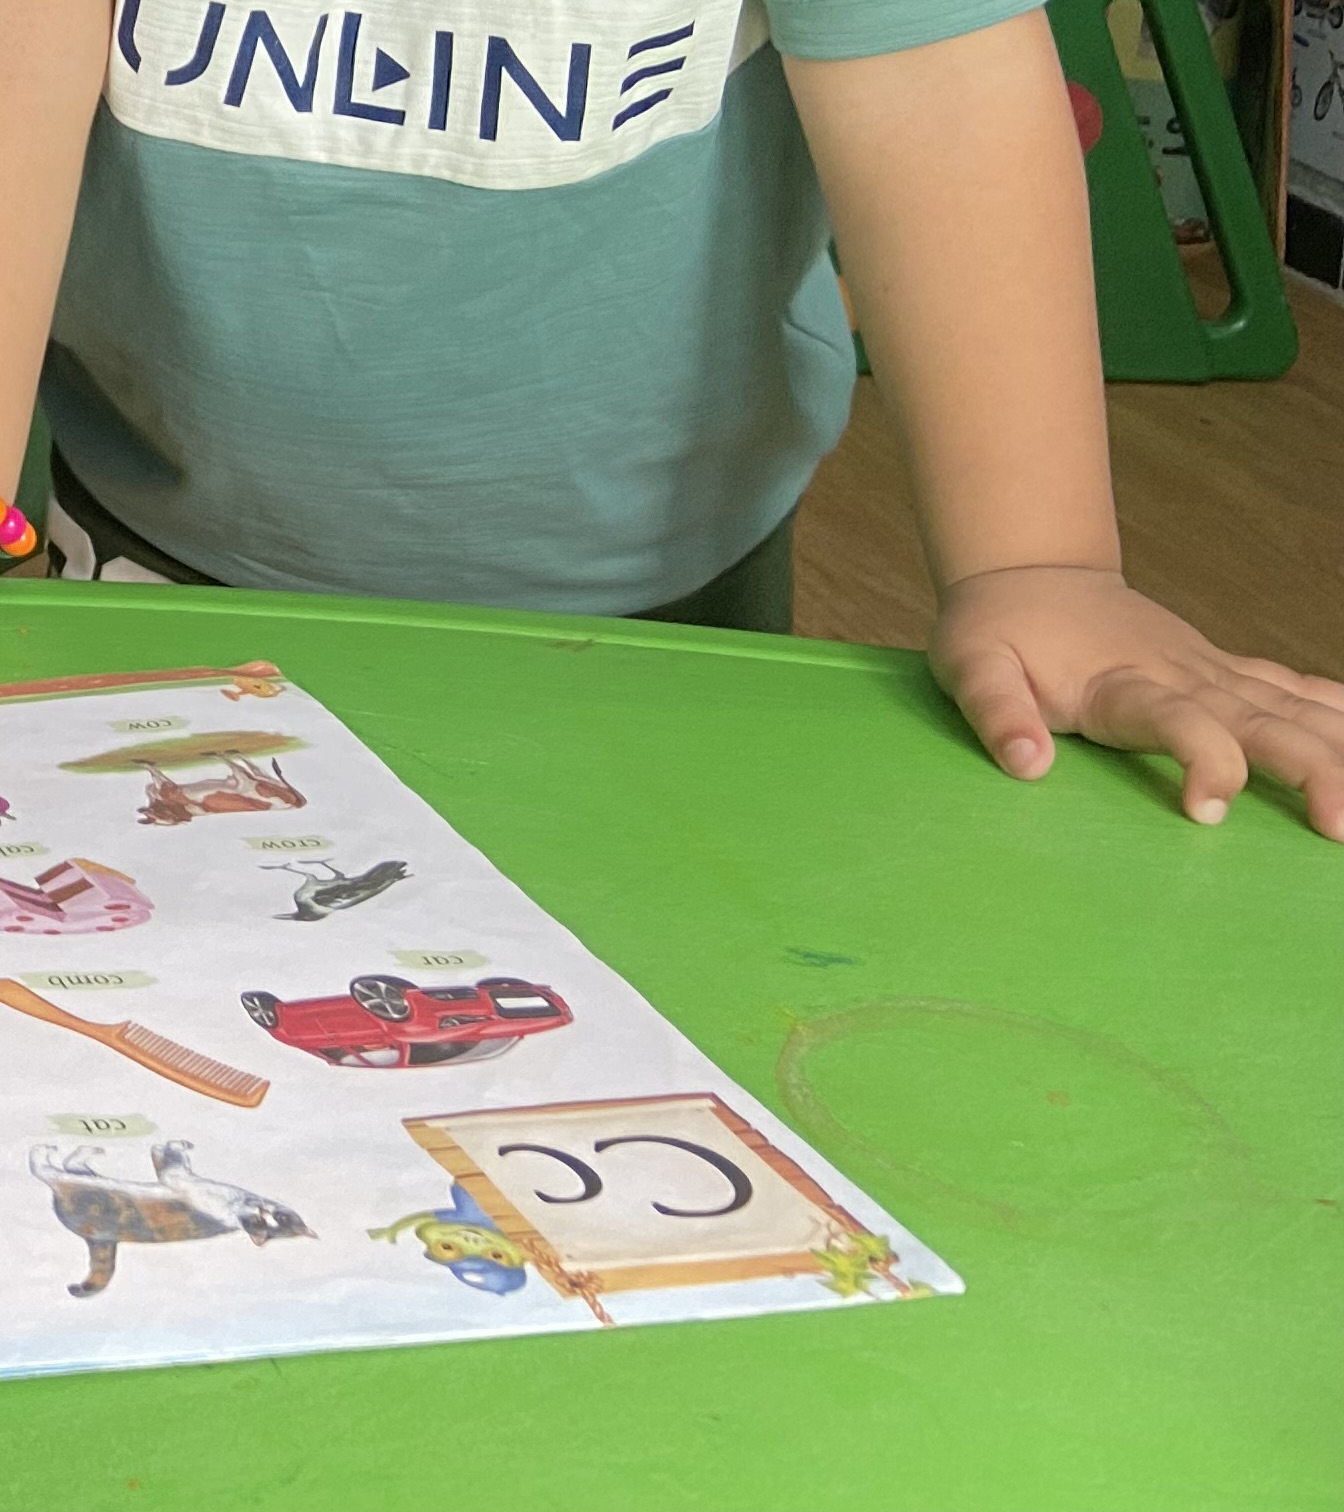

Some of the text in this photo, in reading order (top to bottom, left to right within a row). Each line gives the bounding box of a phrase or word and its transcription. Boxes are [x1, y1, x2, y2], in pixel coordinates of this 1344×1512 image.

[127, 718, 174, 732] cow
[260, 837, 322, 851] crow
[421, 954, 465, 967] car
[46, 974, 125, 991] comb
[80, 1118, 128, 1135] cat
[498, 1135, 754, 1218] Cc
